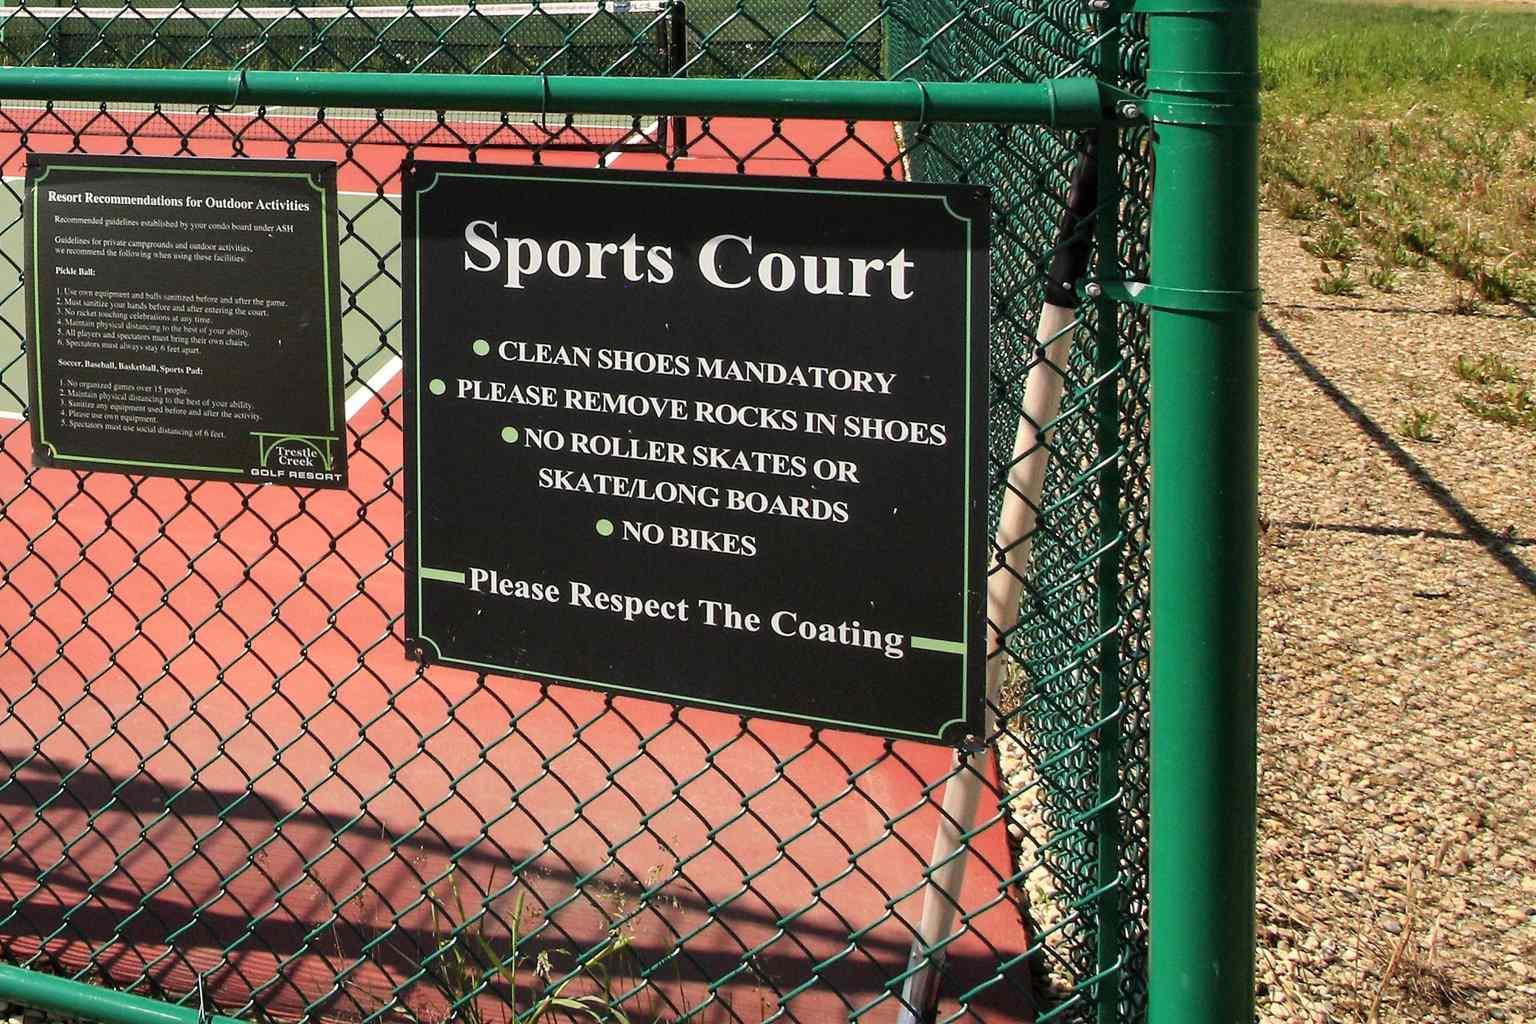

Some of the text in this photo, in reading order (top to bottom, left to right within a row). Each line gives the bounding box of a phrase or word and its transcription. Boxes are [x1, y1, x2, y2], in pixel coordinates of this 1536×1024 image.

[48, 191, 310, 211] Resort Recommendations for Outdoor Activities
[56, 267, 95, 276] Pickle Ball:
[464, 220, 915, 300] Sports Court
[58, 359, 203, 375] Soccer, Baseball, Basketball, Sports Pad:
[498, 340, 897, 395] CLEAN SHOES MANDATORY
[457, 378, 947, 446] PLEASE REMOVE ROCKS IN SHOES
[276, 446, 317, 458] Trestle
[278, 456, 313, 467] Creek
[524, 427, 860, 484] NO ROLLER SKATES OR
[251, 468, 342, 481] GOLF RESORT
[538, 467, 849, 523] SKATE/LONG BOARDS
[622, 520, 757, 557] NO BIKES
[469, 567, 905, 659] Please Respect The Coating
